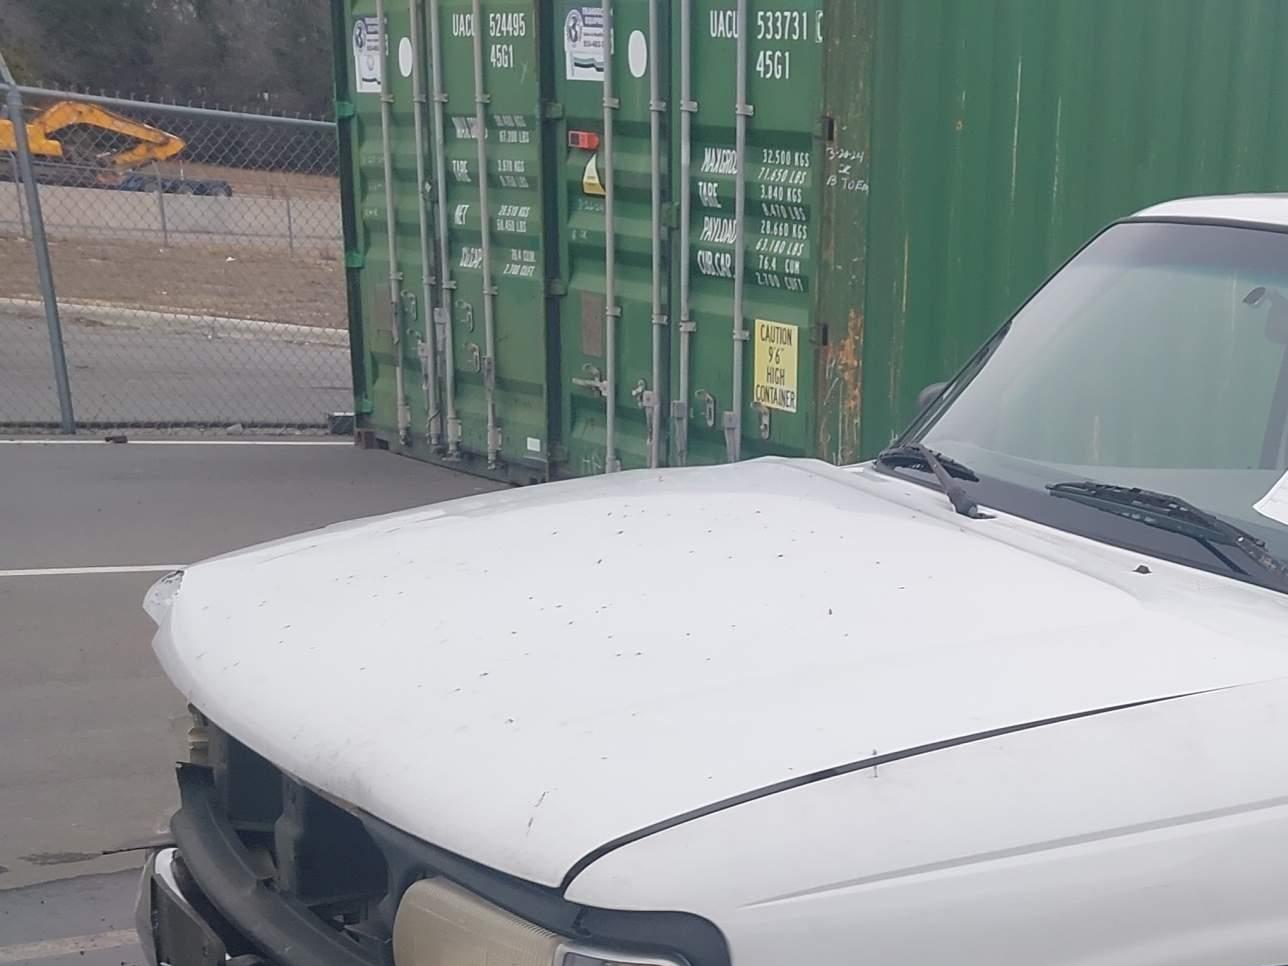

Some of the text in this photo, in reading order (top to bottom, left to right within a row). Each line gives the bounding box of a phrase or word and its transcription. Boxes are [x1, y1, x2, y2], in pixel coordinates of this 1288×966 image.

[489, 13, 526, 37] 524495
[757, 11, 808, 40] 533731
[490, 44, 514, 68] 45G1
[756, 50, 790, 79] 45G1
[762, 148, 791, 166] 32.500
[794, 152, 810, 167] KGS
[789, 170, 808, 185] LBS
[698, 181, 722, 208] TARE
[787, 187, 802, 203] KGS
[761, 219, 789, 237] 28.660
[792, 223, 808, 240] KGS
[786, 242, 805, 256] LBS
[759, 254, 777, 271] 76.4
[784, 258, 800, 274] CUM
[760, 324, 793, 346] CAUTION
[766, 366, 785, 386] HIGH
[755, 384, 796, 409] CONTAINER
